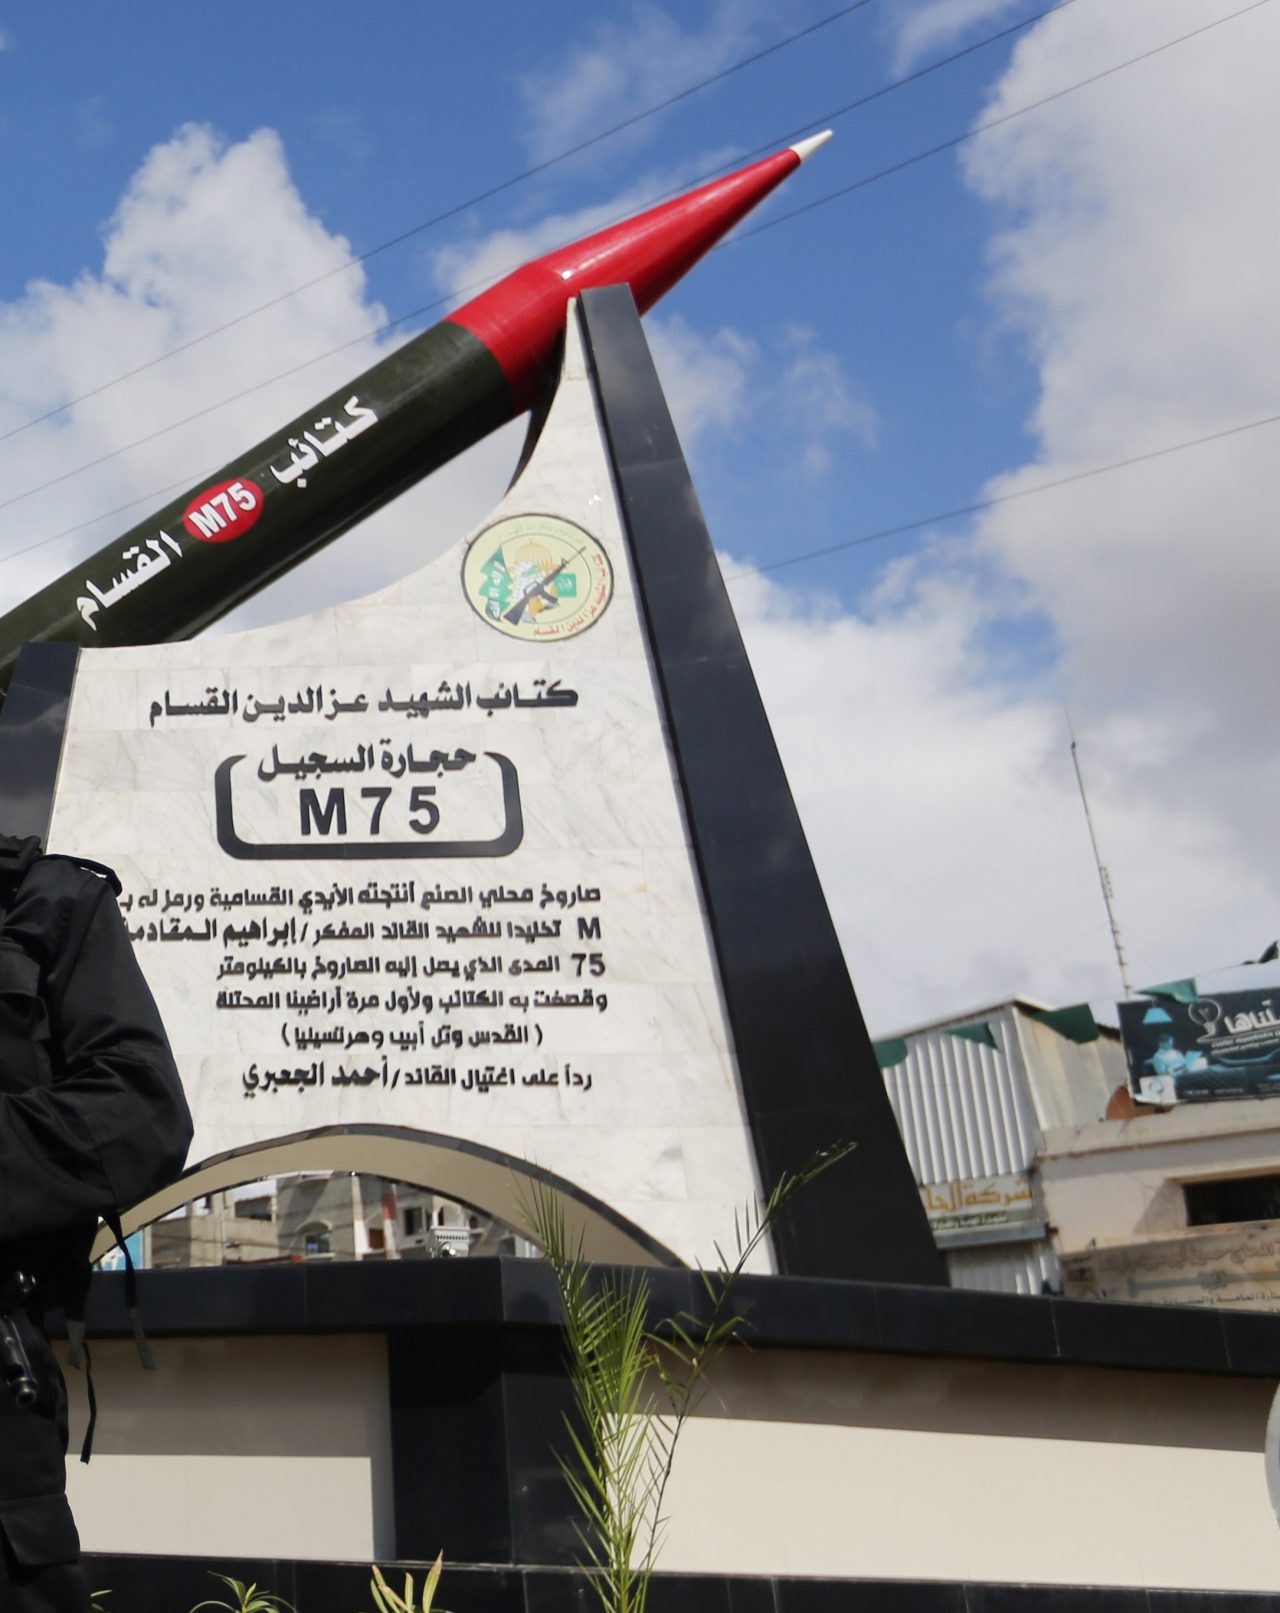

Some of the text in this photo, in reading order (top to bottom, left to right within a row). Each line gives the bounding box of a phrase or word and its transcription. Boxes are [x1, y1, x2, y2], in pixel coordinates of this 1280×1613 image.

[270, 395, 379, 489] كتائب
[188, 481, 258, 540] M75
[75, 530, 183, 632] القسام
[149, 679, 579, 728] كتائب الشهيد عز الدين القسام
[257, 738, 477, 782] حجارة السجيل
[138, 889, 158, 908] له
[161, 889, 205, 912] ورمز
[209, 887, 293, 911] القسامية
[298, 883, 354, 914] الأيدي
[420, 884, 473, 910] الصنع
[479, 885, 534, 908] محلي
[539, 883, 601, 909] صاروخ
[381, 919, 429, 940] القائد
[435, 916, 502, 943] للشهيد
[507, 919, 561, 943] تخليدا
[577, 916, 602, 940] M
[216, 952, 606, 981] 75 المدى الذي يصل إليه الصاروخ بالكيلومتر
[216, 985, 608, 1016] وقصفت به الكتائب ولأول مرة أراضينا المحتلة
[389, 1020, 424, 1051] أبيب
[431, 1025, 463, 1049] وتل
[468, 1023, 529, 1048] القدس
[242, 1061, 325, 1098] الجعبري
[331, 1055, 388, 1087] أحمد
[404, 1065, 456, 1086] القائد
[461, 1066, 516, 1093] اغتيال
[521, 1069, 559, 1086] على
